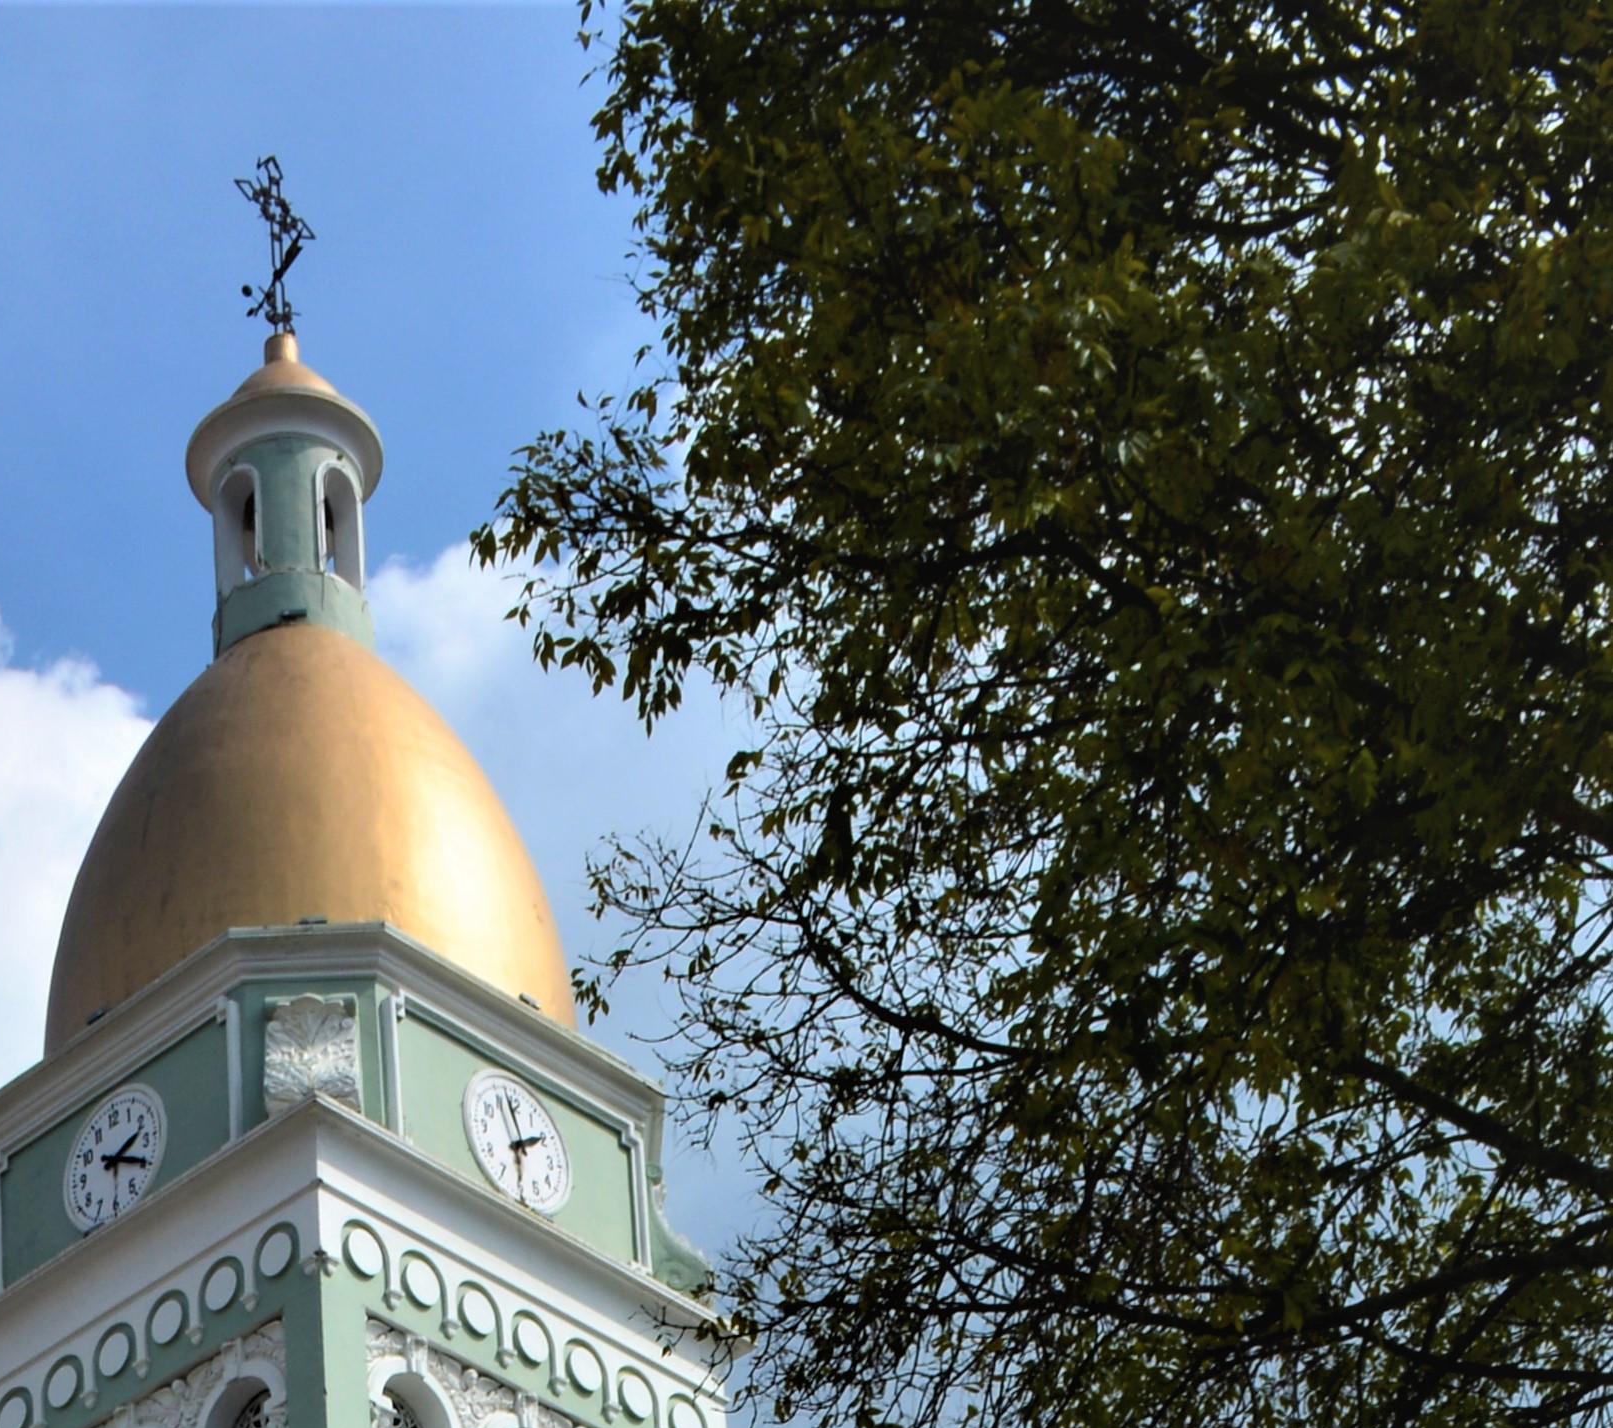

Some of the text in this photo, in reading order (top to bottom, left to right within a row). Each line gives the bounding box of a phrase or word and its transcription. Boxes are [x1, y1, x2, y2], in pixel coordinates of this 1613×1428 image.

[126, 1107, 132, 1124] 1
[483, 1101, 494, 1119] 10
[107, 1109, 120, 1129] 12
[137, 1114, 146, 1131] 2
[480, 1118, 488, 1134] 9
[529, 1112, 534, 1128] 1
[94, 1127, 103, 1146] 11
[142, 1132, 150, 1149] 3
[539, 1131, 548, 1148] 2
[82, 1148, 94, 1168] 10
[486, 1142, 495, 1158] 8
[499, 1161, 508, 1182] 7
[546, 1155, 555, 1172] 3
[79, 1173, 88, 1191] 9
[128, 1177, 137, 1195] 5
[544, 1174, 552, 1190] 4
[84, 1191, 93, 1208] 8
[112, 1194, 121, 1212] 6
[94, 1198, 104, 1224] 7
